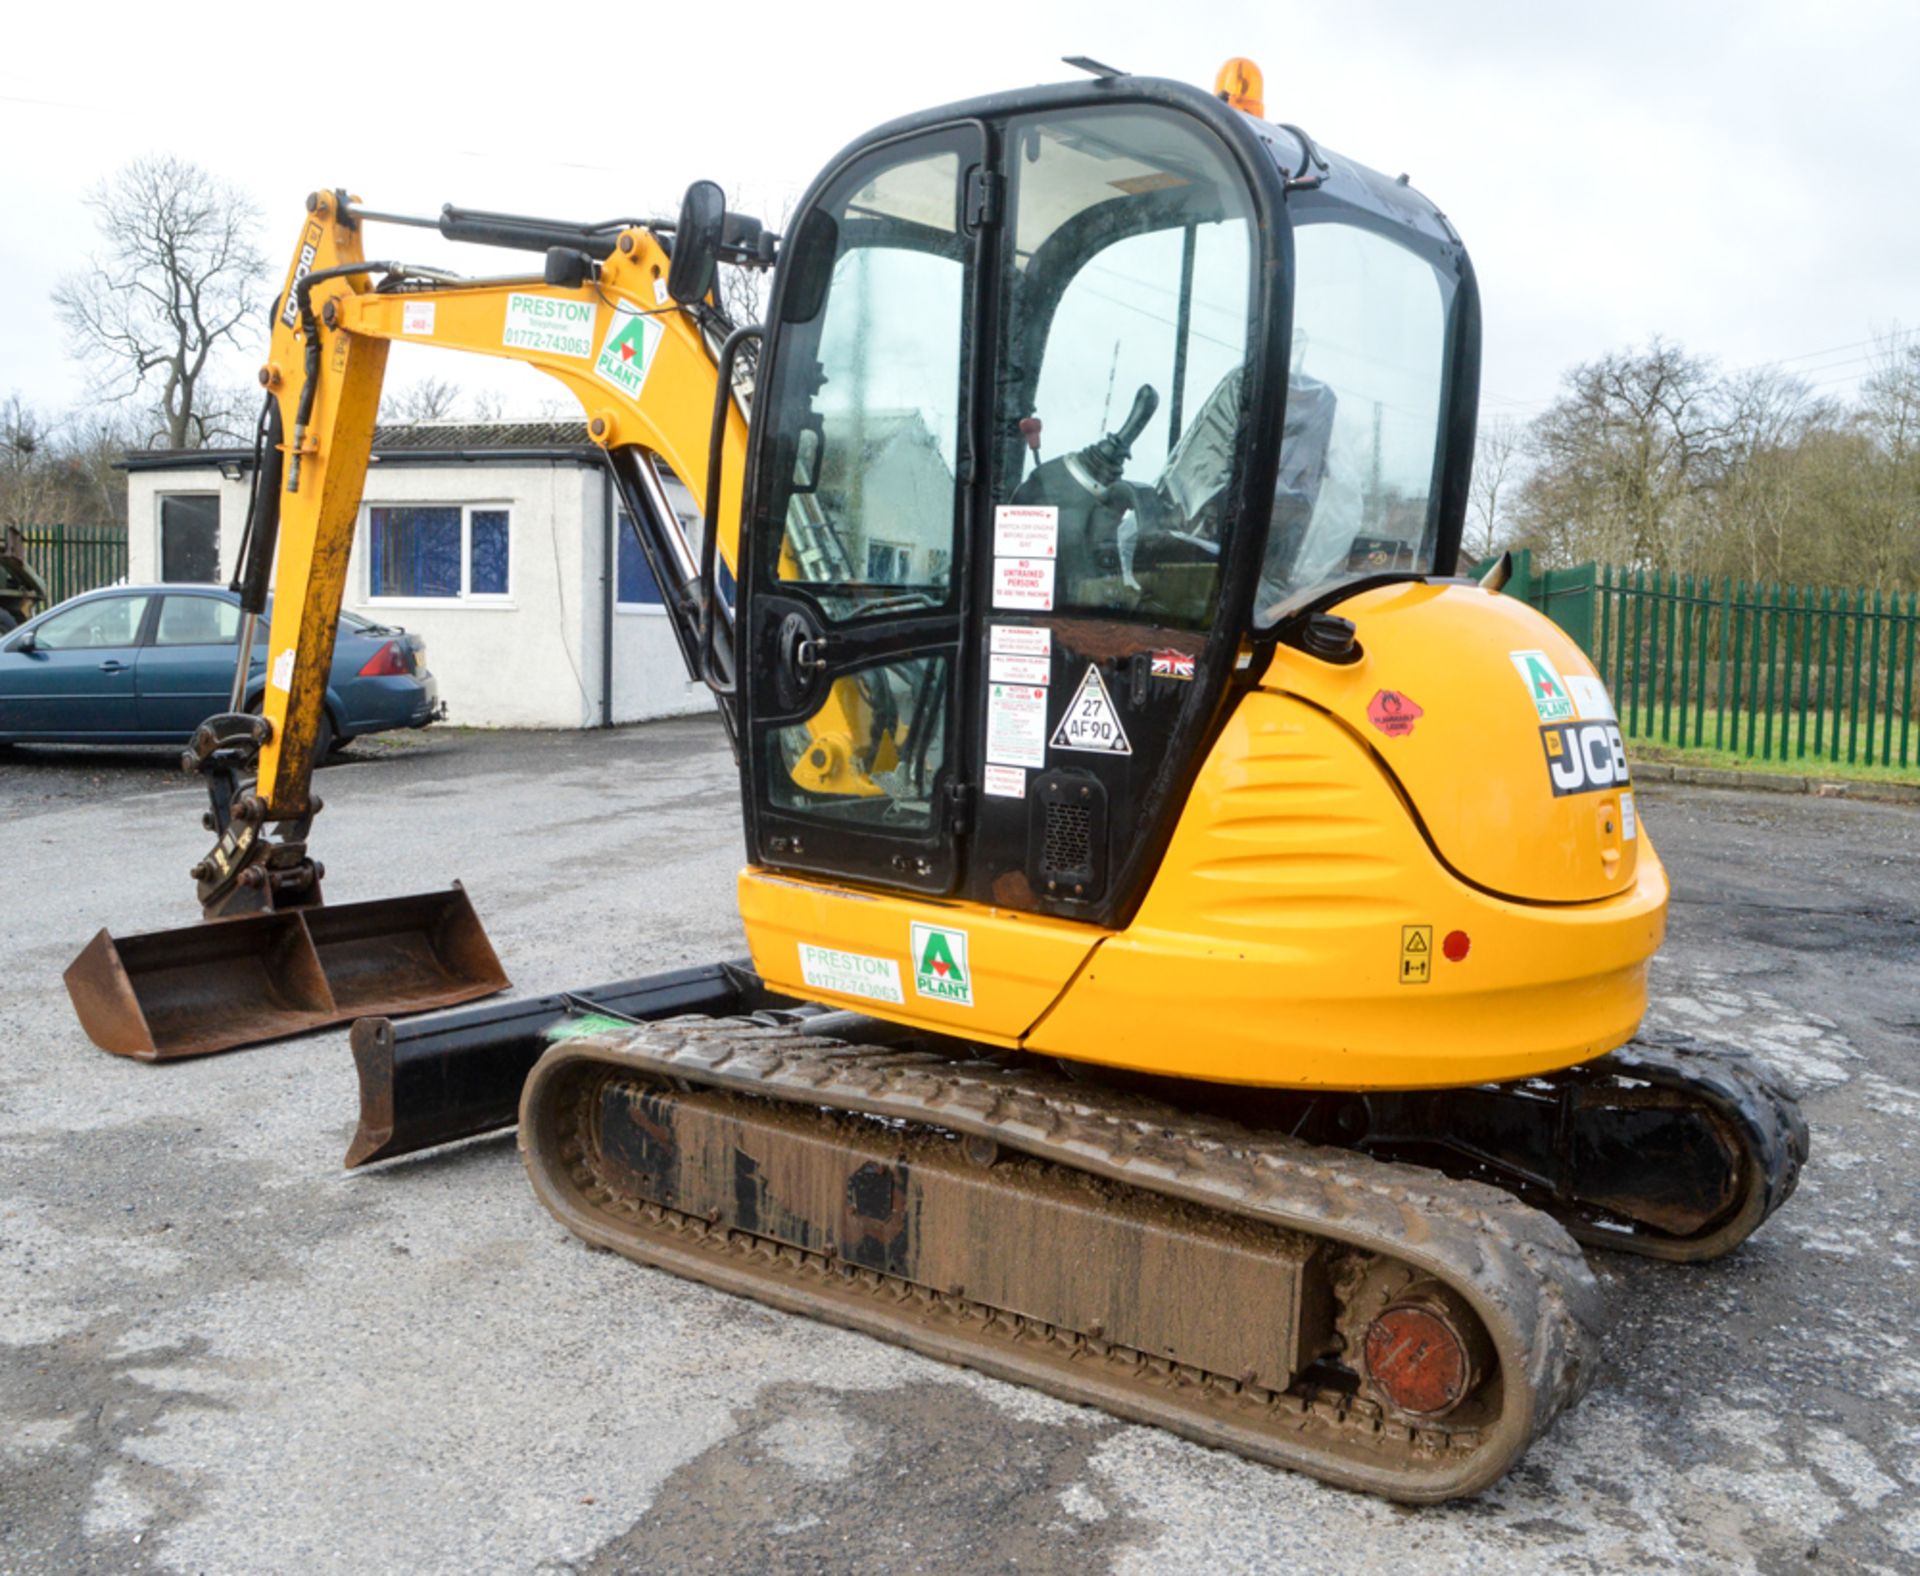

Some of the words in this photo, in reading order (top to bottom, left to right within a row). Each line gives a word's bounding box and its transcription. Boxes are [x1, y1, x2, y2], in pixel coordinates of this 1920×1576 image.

[284, 244, 316, 315] 800
[511, 296, 590, 323] PRESTON
[505, 328, 590, 355] 01772-743063
[607, 315, 645, 371] A
[598, 353, 642, 390] PLANT
[1009, 509, 1045, 518] WARNING
[1003, 569, 1045, 579] UNTRAINED
[1018, 560, 1030, 569] NO
[1007, 578, 1040, 588] PERSONS
[1525, 655, 1566, 699] A
[1082, 700, 1102, 717] 27
[1537, 700, 1572, 718] PLANT
[1551, 724, 1630, 790] JCB
[806, 946, 890, 978] PRESTON
[920, 931, 964, 981] A
[917, 977, 969, 999] PLANT
